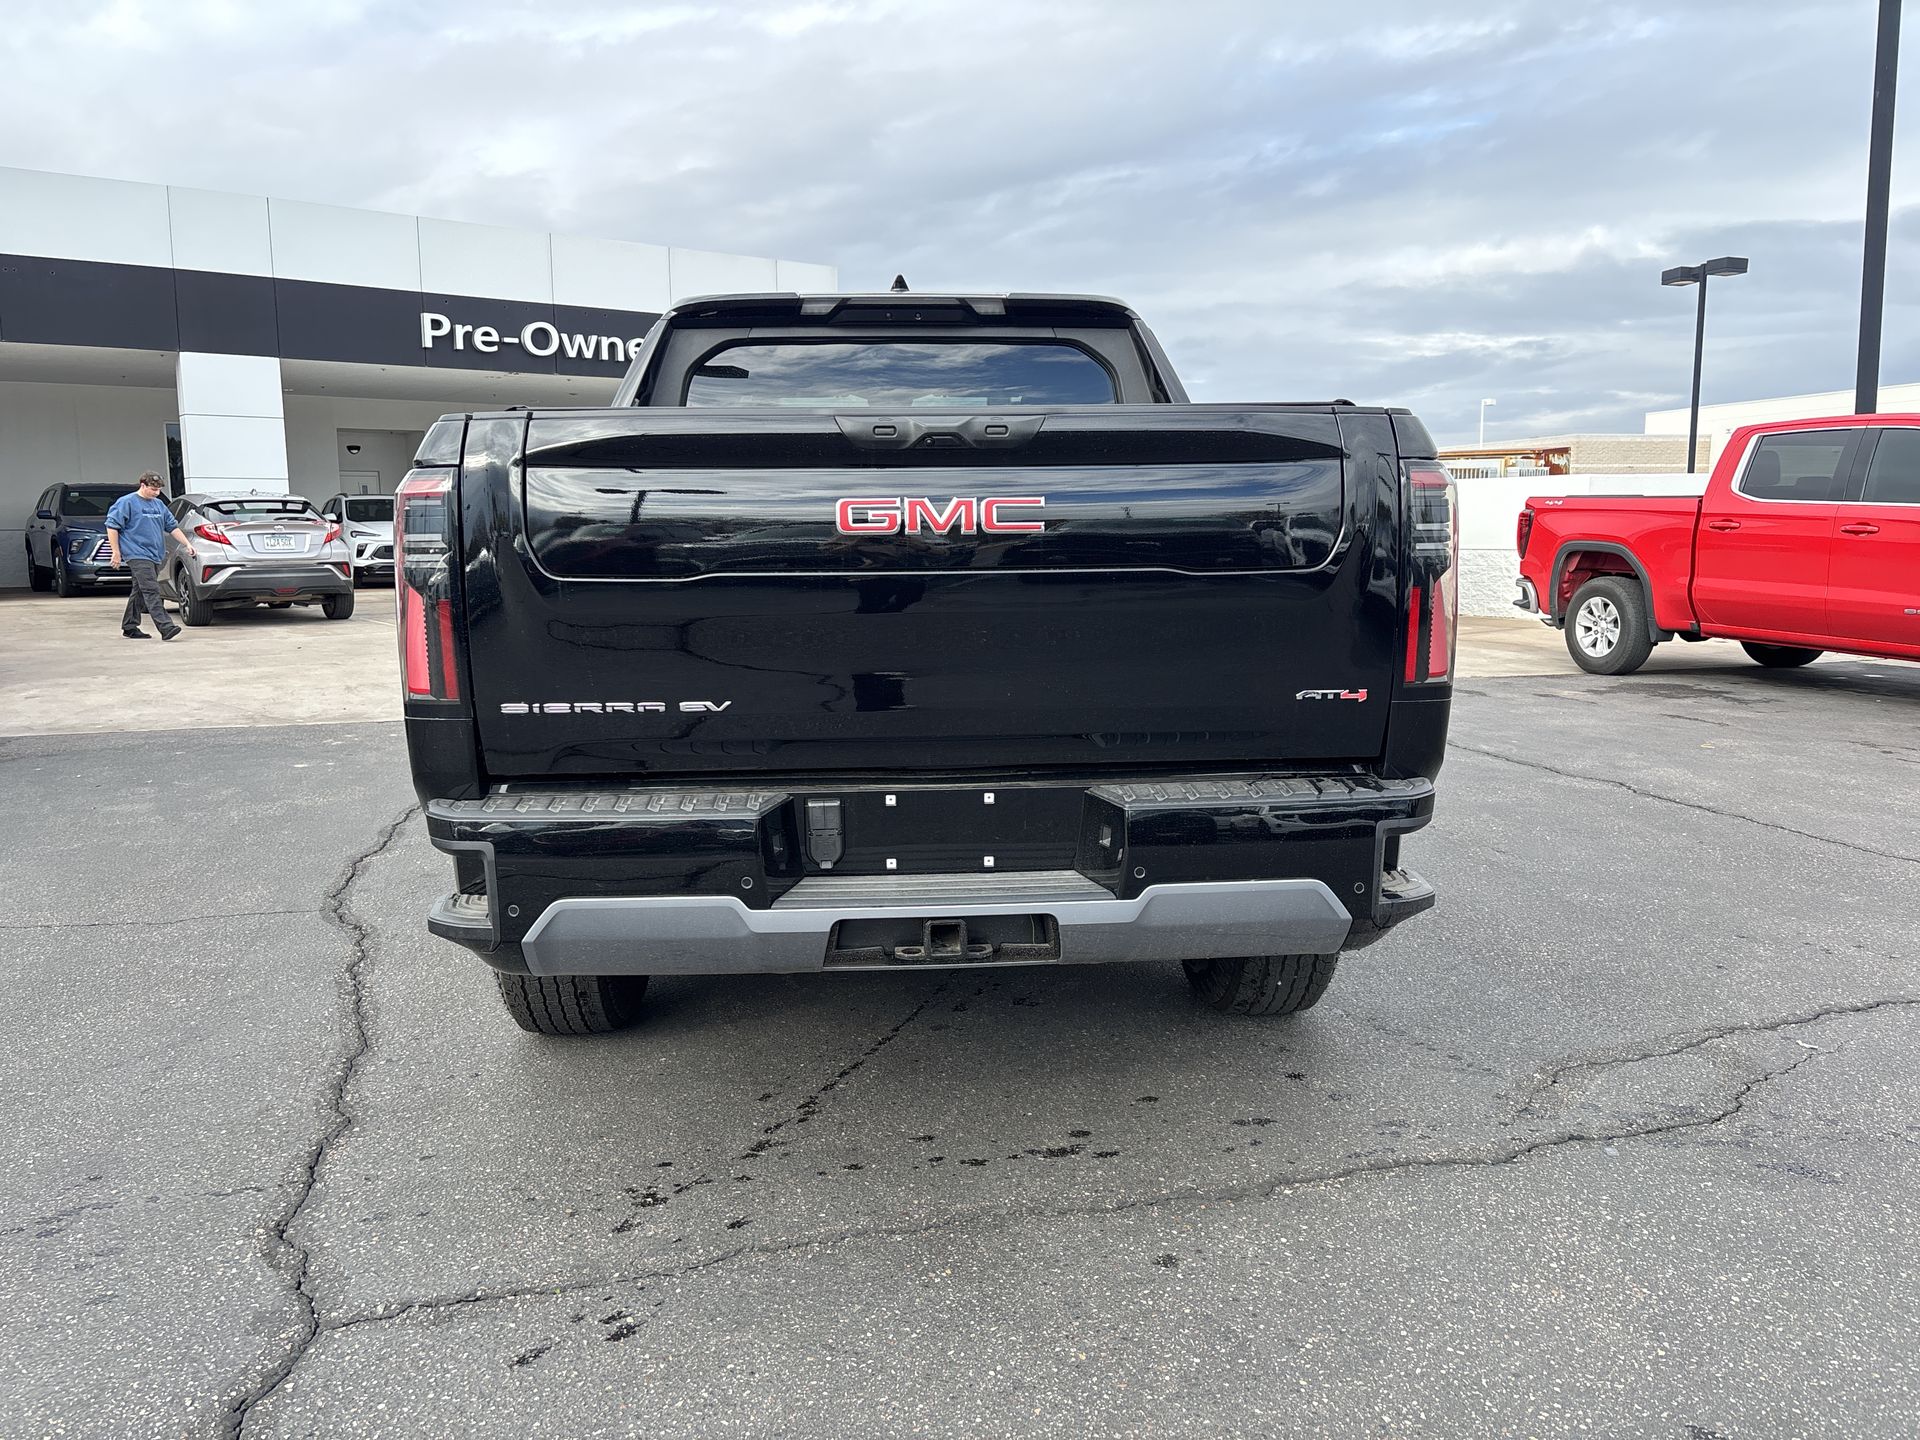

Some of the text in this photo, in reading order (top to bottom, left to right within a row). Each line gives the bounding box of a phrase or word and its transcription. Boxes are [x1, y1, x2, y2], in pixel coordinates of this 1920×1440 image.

[835, 496, 1046, 536] GMC
[1295, 688, 1368, 703] AT4
[500, 700, 732, 714] SIERRA EV
